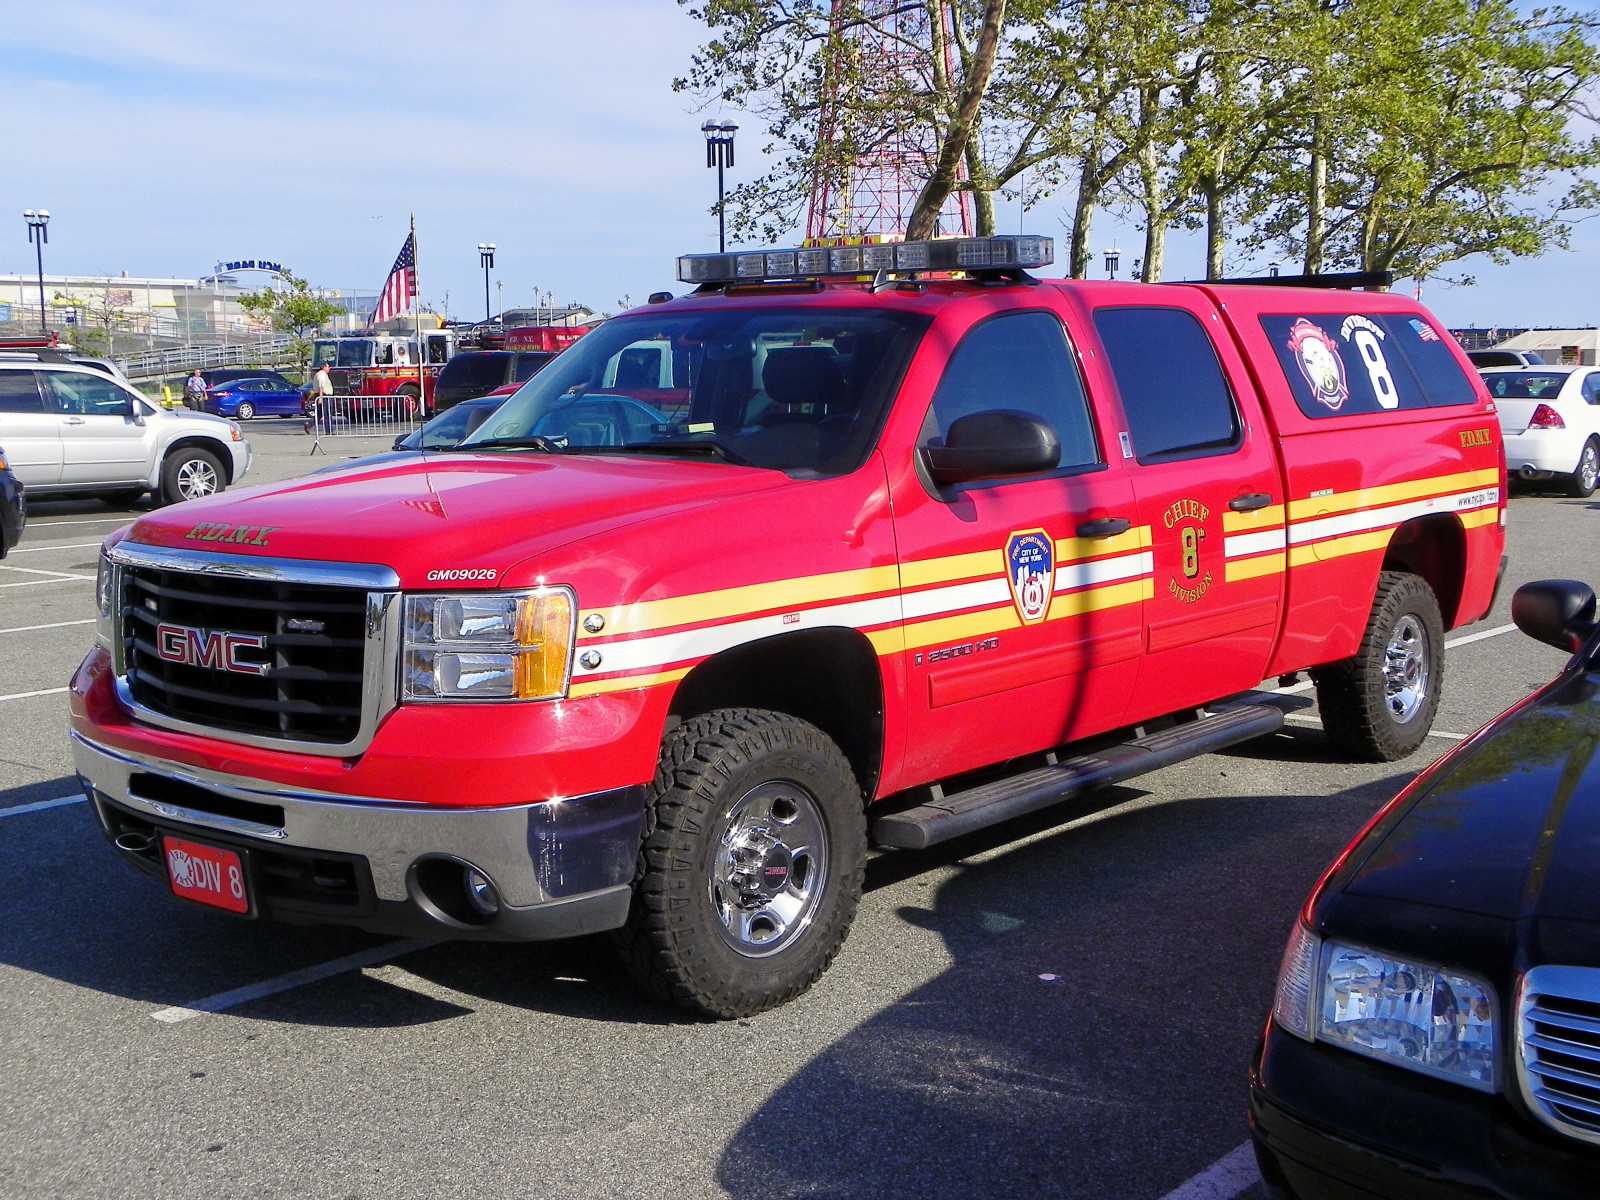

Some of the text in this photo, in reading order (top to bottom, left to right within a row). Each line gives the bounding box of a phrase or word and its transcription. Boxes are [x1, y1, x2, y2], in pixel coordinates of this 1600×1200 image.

[1341, 315, 1386, 342] DIVISION
[1355, 330, 1399, 409] 8
[1164, 498, 1210, 529] CHIEF
[186, 521, 281, 547] F.D.N.Y.
[1012, 536, 1049, 561] FIRE DEPARTMENT
[1019, 554, 1043, 564] NEW YORK
[1021, 547, 1039, 557] CITY OF
[426, 568, 497, 582] GM09026
[1168, 569, 1214, 605] DIVISION
[157, 622, 271, 677] GMC
[928, 637, 999, 664] 2500 HD
[191, 856, 243, 899] DIV 8
